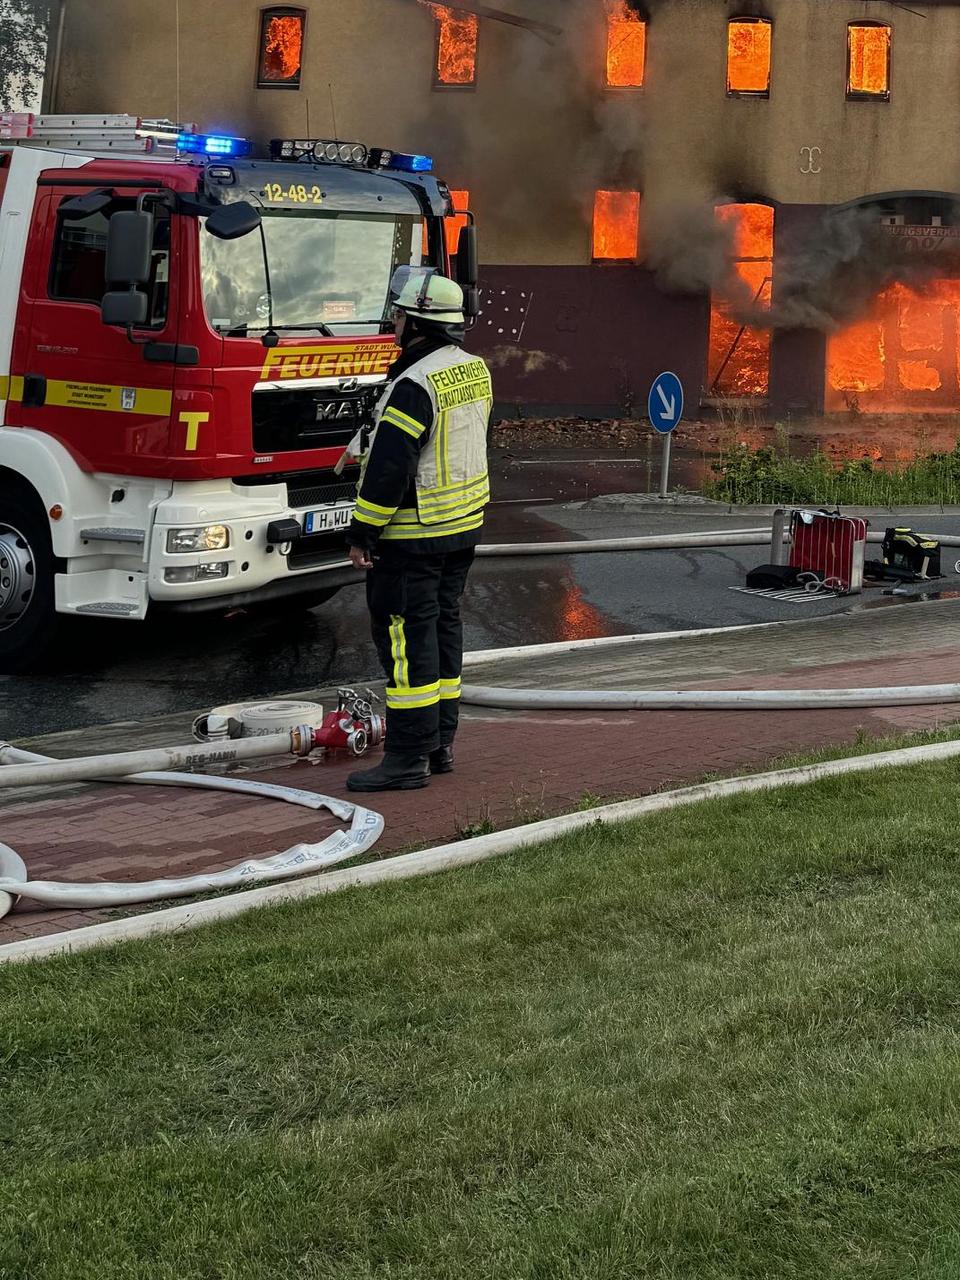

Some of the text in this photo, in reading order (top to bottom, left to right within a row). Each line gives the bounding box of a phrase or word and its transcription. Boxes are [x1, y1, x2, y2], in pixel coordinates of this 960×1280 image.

[264, 183, 322, 204] 12-48-2
[430, 361, 488, 389] FEUERWEHR
[179, 412, 209, 450] T
